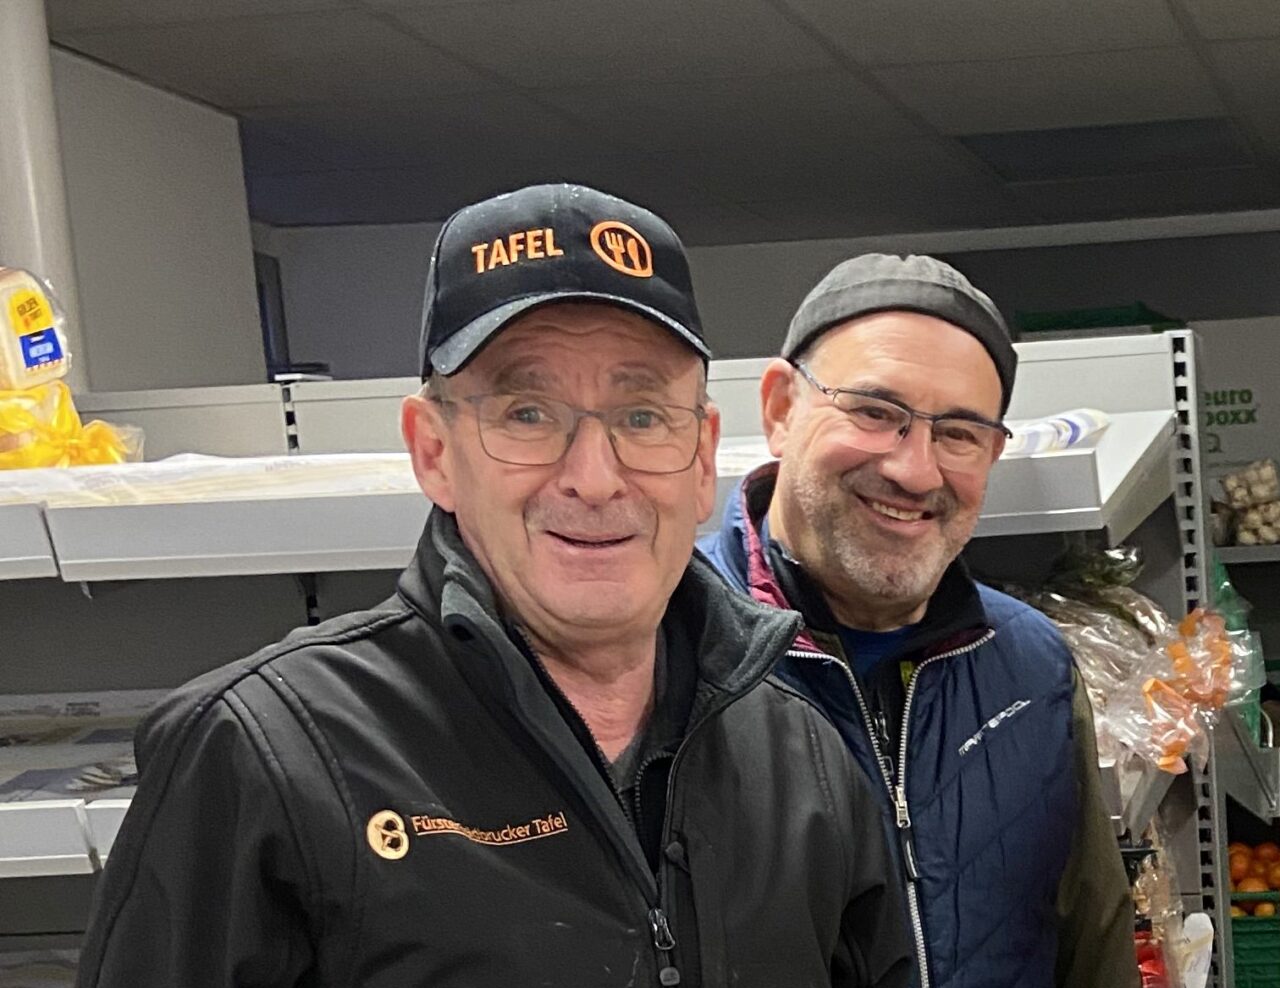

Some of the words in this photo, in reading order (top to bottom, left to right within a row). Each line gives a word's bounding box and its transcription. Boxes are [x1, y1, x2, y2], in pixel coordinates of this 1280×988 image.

[471, 228, 564, 274] TAFEL
[412, 815, 530, 842] Fürstedbrucker
[532, 811, 568, 836] Tafel
